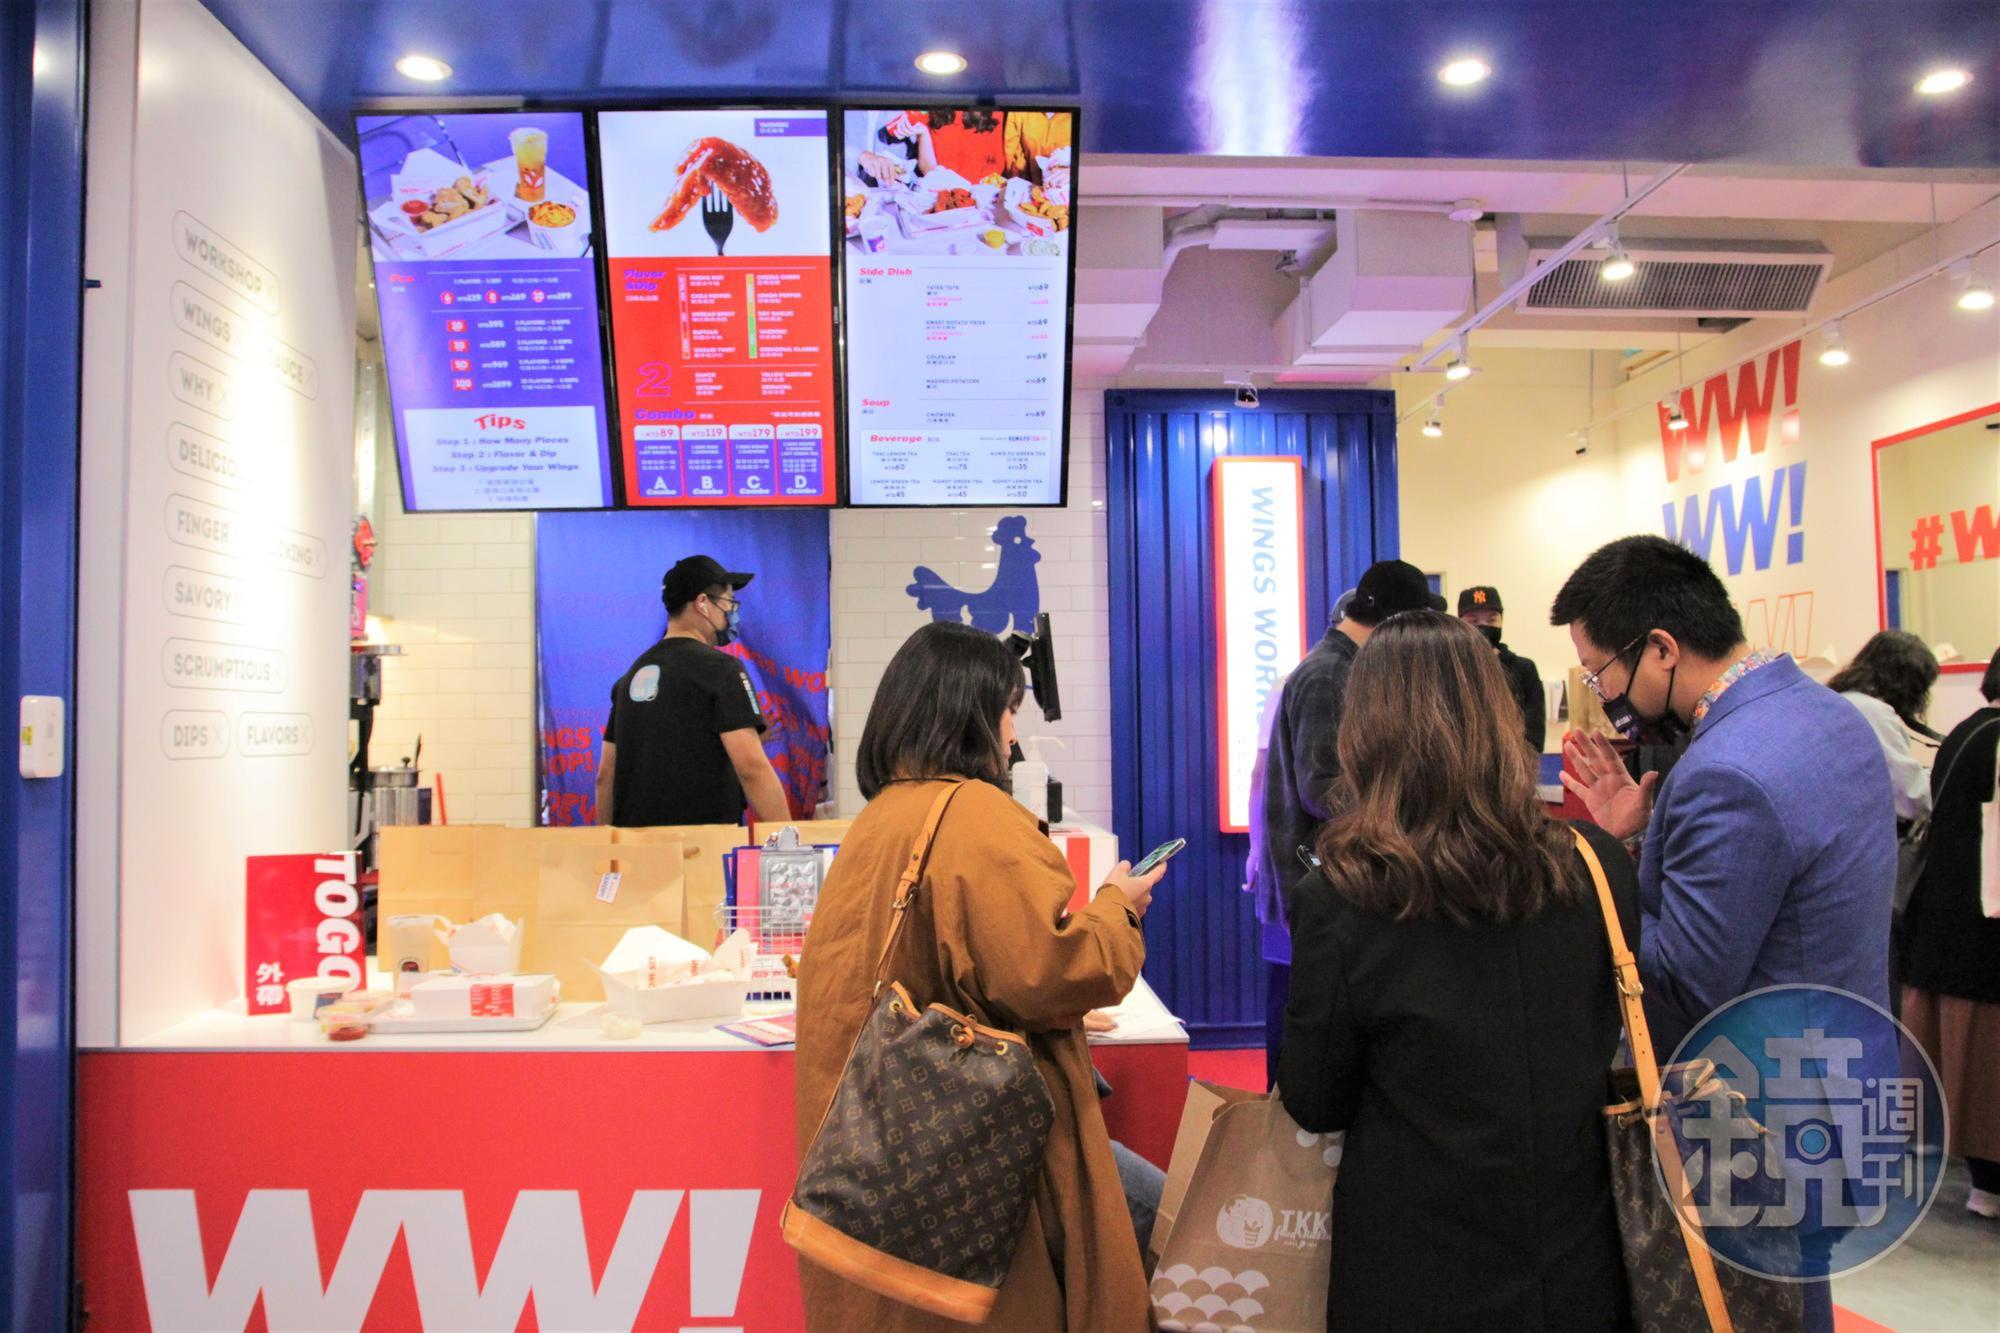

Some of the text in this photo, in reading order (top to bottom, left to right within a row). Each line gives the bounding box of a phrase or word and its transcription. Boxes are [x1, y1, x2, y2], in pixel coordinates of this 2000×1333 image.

[184, 228, 262, 293] WORKSHOP
[859, 267, 912, 276] Side Dish
[183, 298, 231, 342] WINGS
[180, 366, 215, 401] WHY
[862, 399, 890, 408] Soup
[474, 414, 526, 430] Tips
[634, 408, 696, 421] Combo
[436, 438, 460, 446] Step
[504, 436, 532, 445] Many
[535, 436, 569, 444] Pieces
[870, 435, 922, 443] Beverage
[451, 451, 474, 459] Step
[494, 450, 526, 458] Flavor
[539, 450, 557, 459] Dip
[433, 465, 455, 473] Step
[475, 464, 519, 473] Upgrade
[547, 463, 579, 471] Wings
[654, 476, 668, 490] A
[701, 475, 714, 490] B
[746, 475, 761, 489] C
[794, 475, 808, 489] D
[176, 509, 230, 543] FINGER
[1251, 486, 1277, 594] WINGS
[175, 581, 232, 611] SAVORY
[173, 652, 272, 682] SCRUMPTIOUS
[173, 724, 208, 748] DIPS
[247, 724, 299, 746] FLAVORS
[1280, 1210, 1330, 1233] TKK
